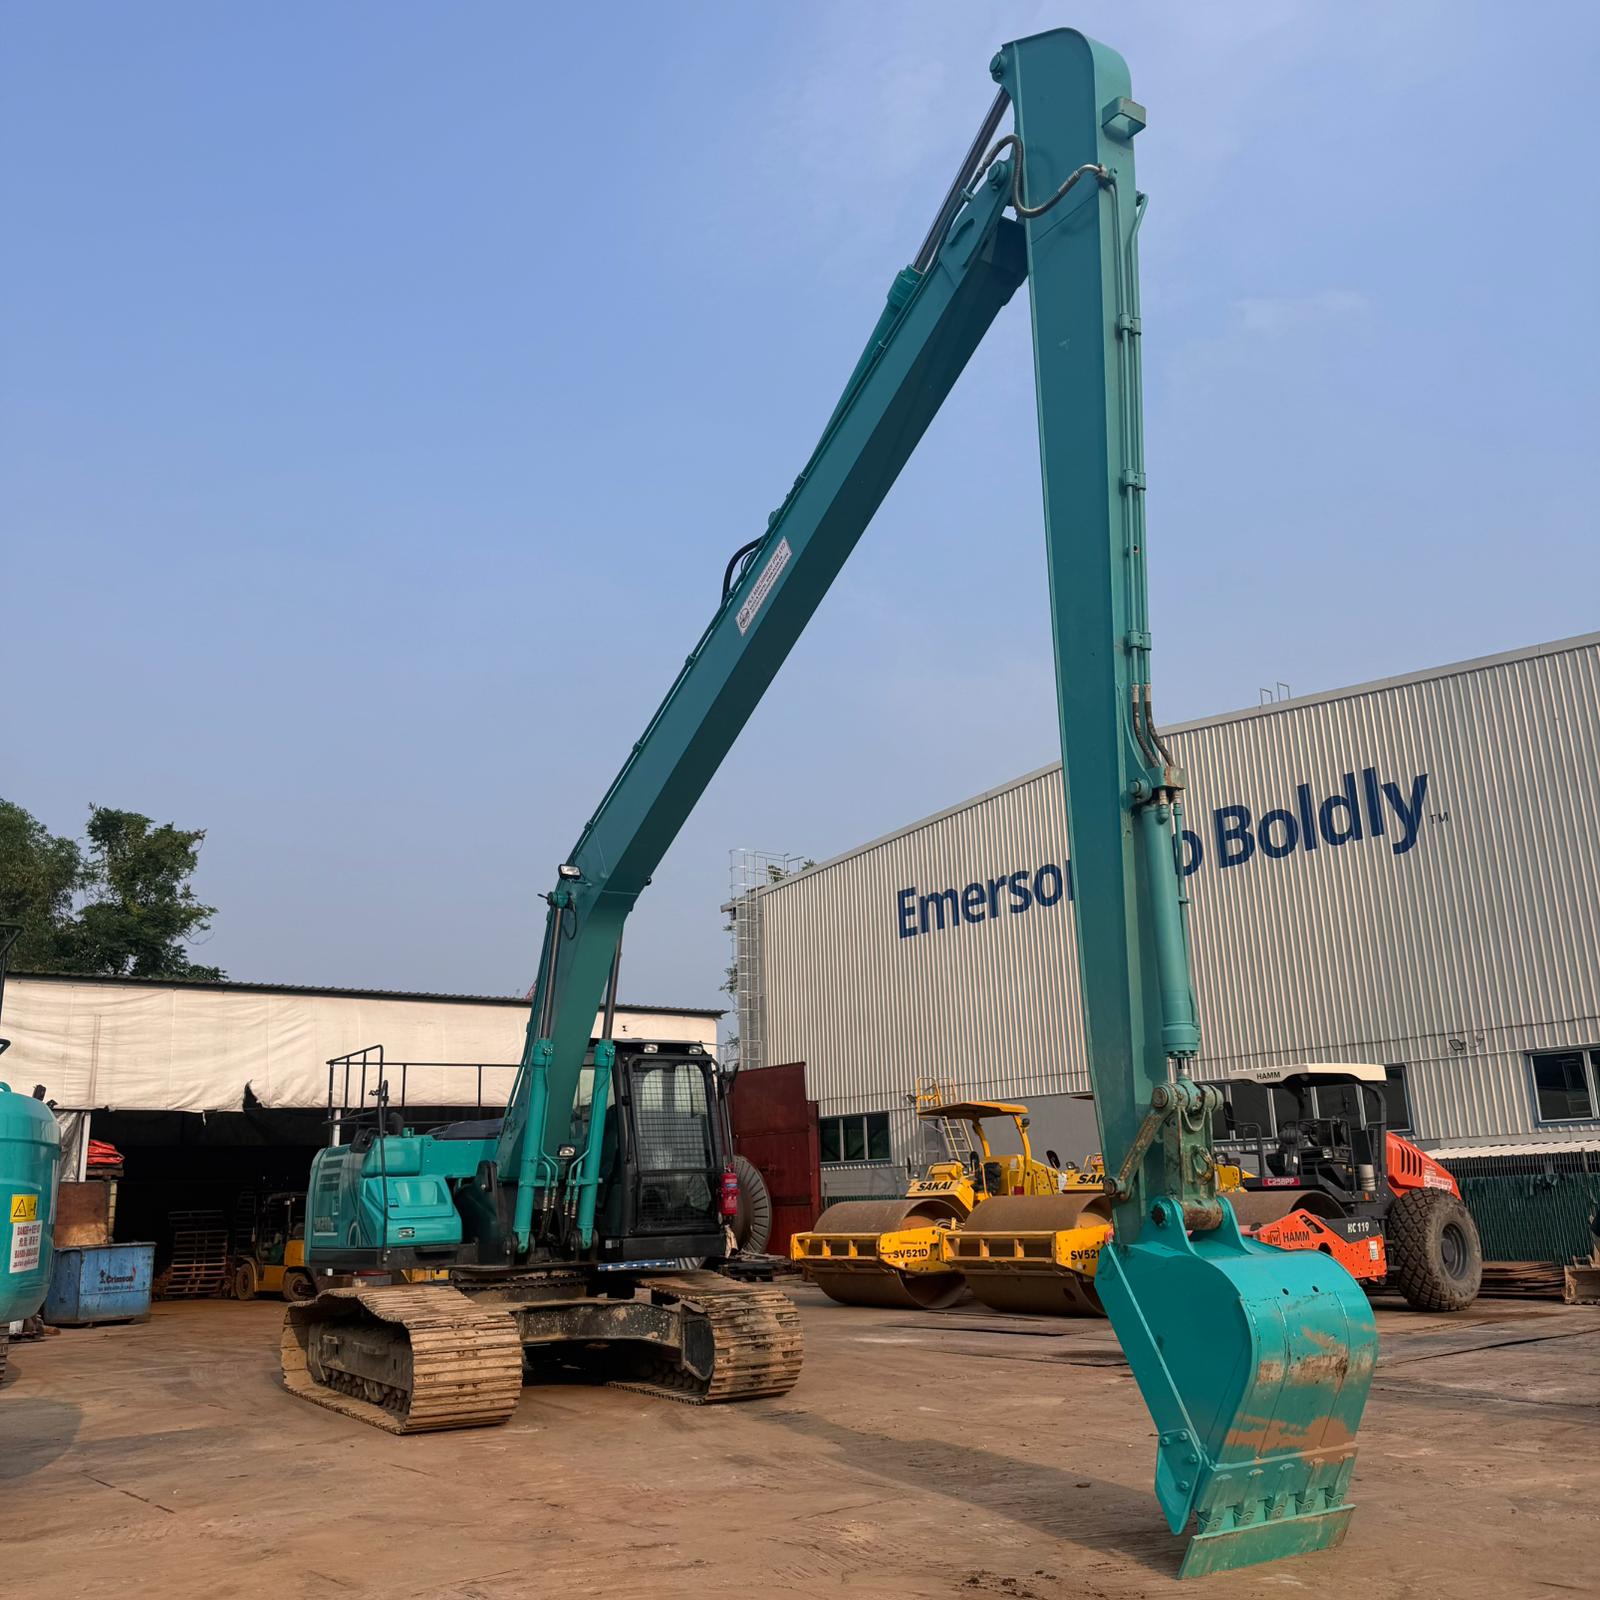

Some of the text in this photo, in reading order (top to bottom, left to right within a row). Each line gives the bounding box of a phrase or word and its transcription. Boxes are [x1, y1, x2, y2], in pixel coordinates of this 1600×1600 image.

[1213, 766, 1428, 869] Boldly
[1256, 1072, 1281, 1080] HAMM
[1077, 1174, 1105, 1185] SAK
[917, 1181, 953, 1192] SAKAI
[1357, 1222, 1370, 1232] 119
[1282, 1231, 1310, 1243] HAMM
[893, 1248, 928, 1259] SV521D
[1070, 1250, 1101, 1261] SV521
[106, 1275, 134, 1284] Crimson
